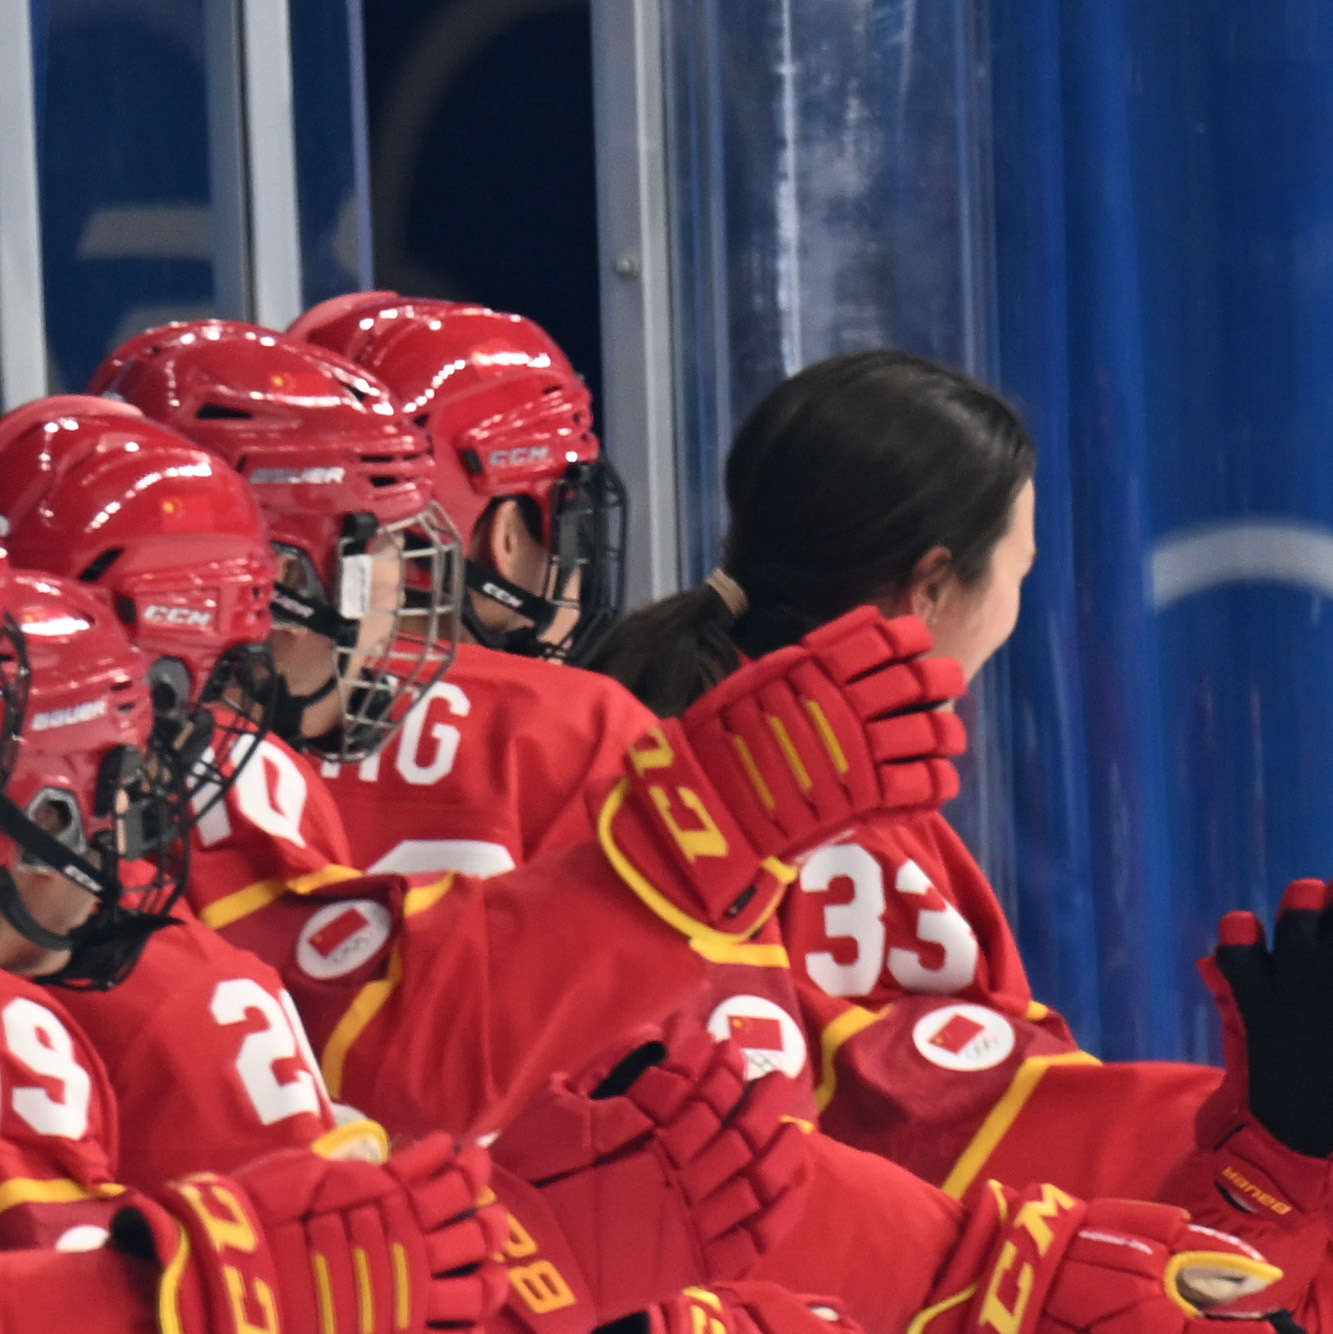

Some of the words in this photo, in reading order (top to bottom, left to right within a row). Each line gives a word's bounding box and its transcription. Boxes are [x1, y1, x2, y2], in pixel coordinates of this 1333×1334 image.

[489, 447, 550, 467] CCM
[144, 603, 214, 627] CCM
[800, 843, 980, 997] 33
[2, 996, 92, 1141] 9
